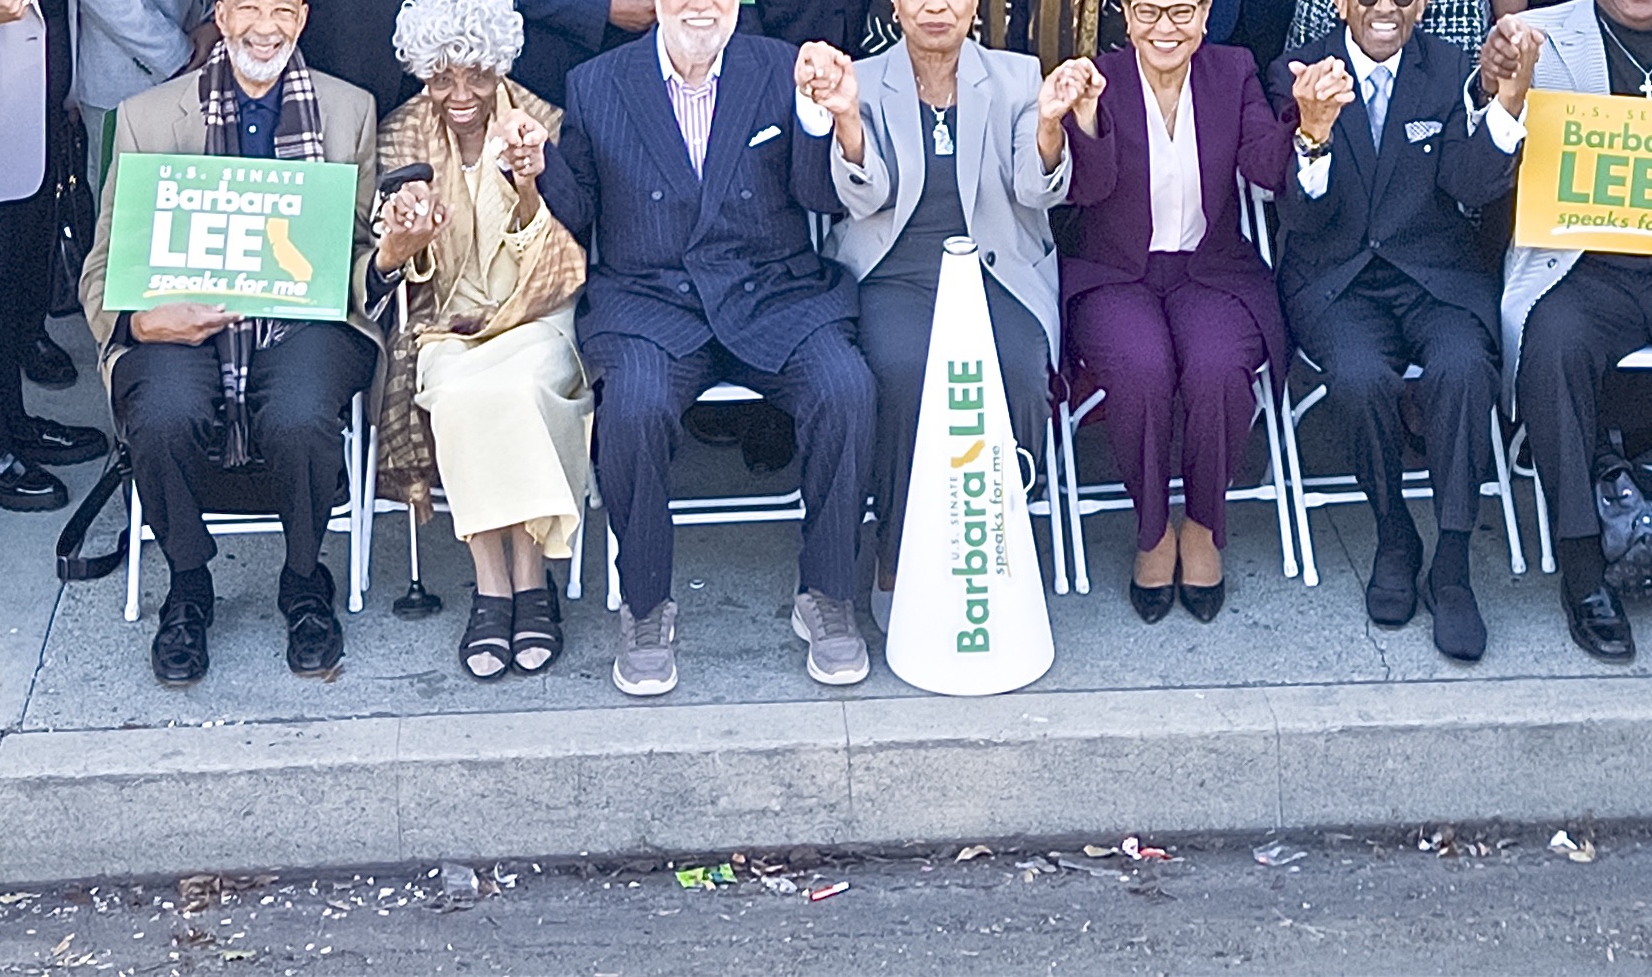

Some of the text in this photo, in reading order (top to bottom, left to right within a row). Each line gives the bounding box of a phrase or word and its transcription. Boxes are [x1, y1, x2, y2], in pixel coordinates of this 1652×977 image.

[1566, 105, 1609, 118] U.S.
[160, 165, 305, 184] U.S. SENATE
[156, 181, 302, 215] Barbara
[1557, 209, 1629, 228] speaks
[149, 211, 265, 271] LEE
[148, 271, 308, 296] speaks for me
[948, 360, 990, 652] Barbara LEE
[950, 477, 960, 560] U.S. SENATE
[990, 446, 1007, 575] speaks for me
